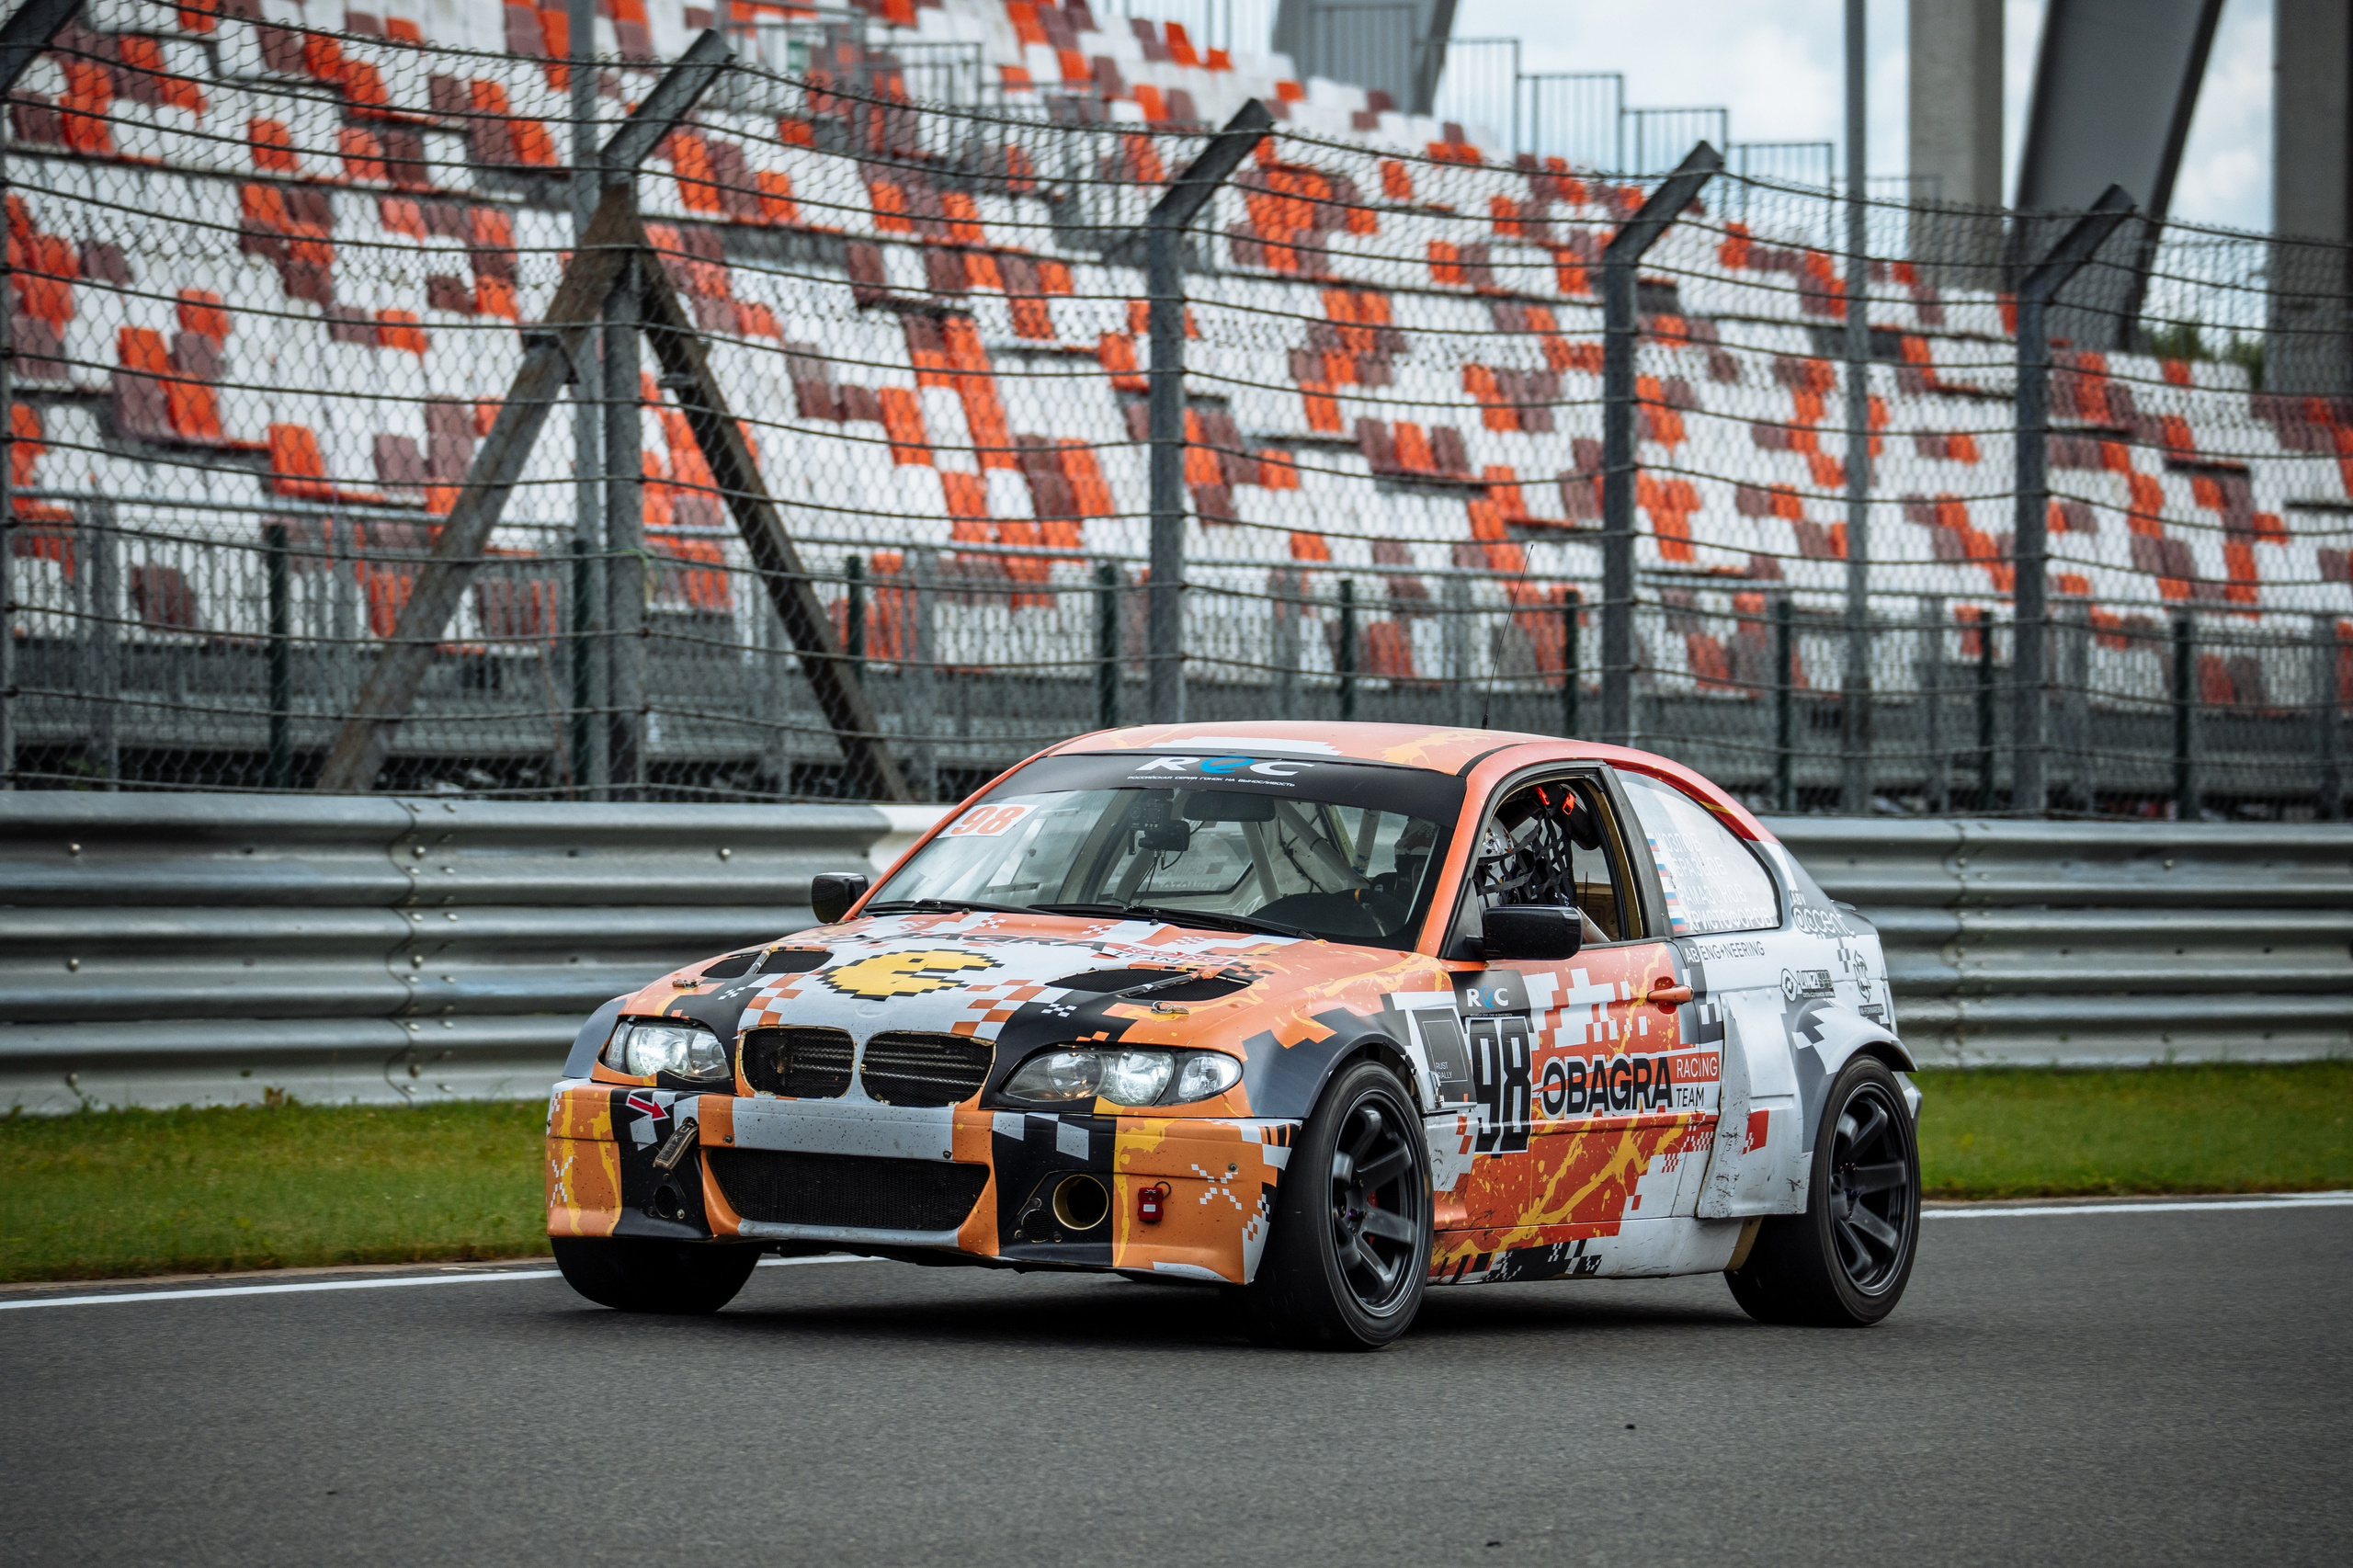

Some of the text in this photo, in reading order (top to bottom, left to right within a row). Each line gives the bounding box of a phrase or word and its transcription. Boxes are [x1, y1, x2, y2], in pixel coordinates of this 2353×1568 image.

[950, 806, 1026, 835] 98
[1113, 950, 1181, 962] TEAM
[1126, 947, 1225, 963] RACING
[1677, 1056, 1718, 1079] RACING
[1470, 1018, 1531, 1152] 98
[1542, 1056, 1673, 1116] OBAGRA
[1677, 1086, 1705, 1108] TEAM
